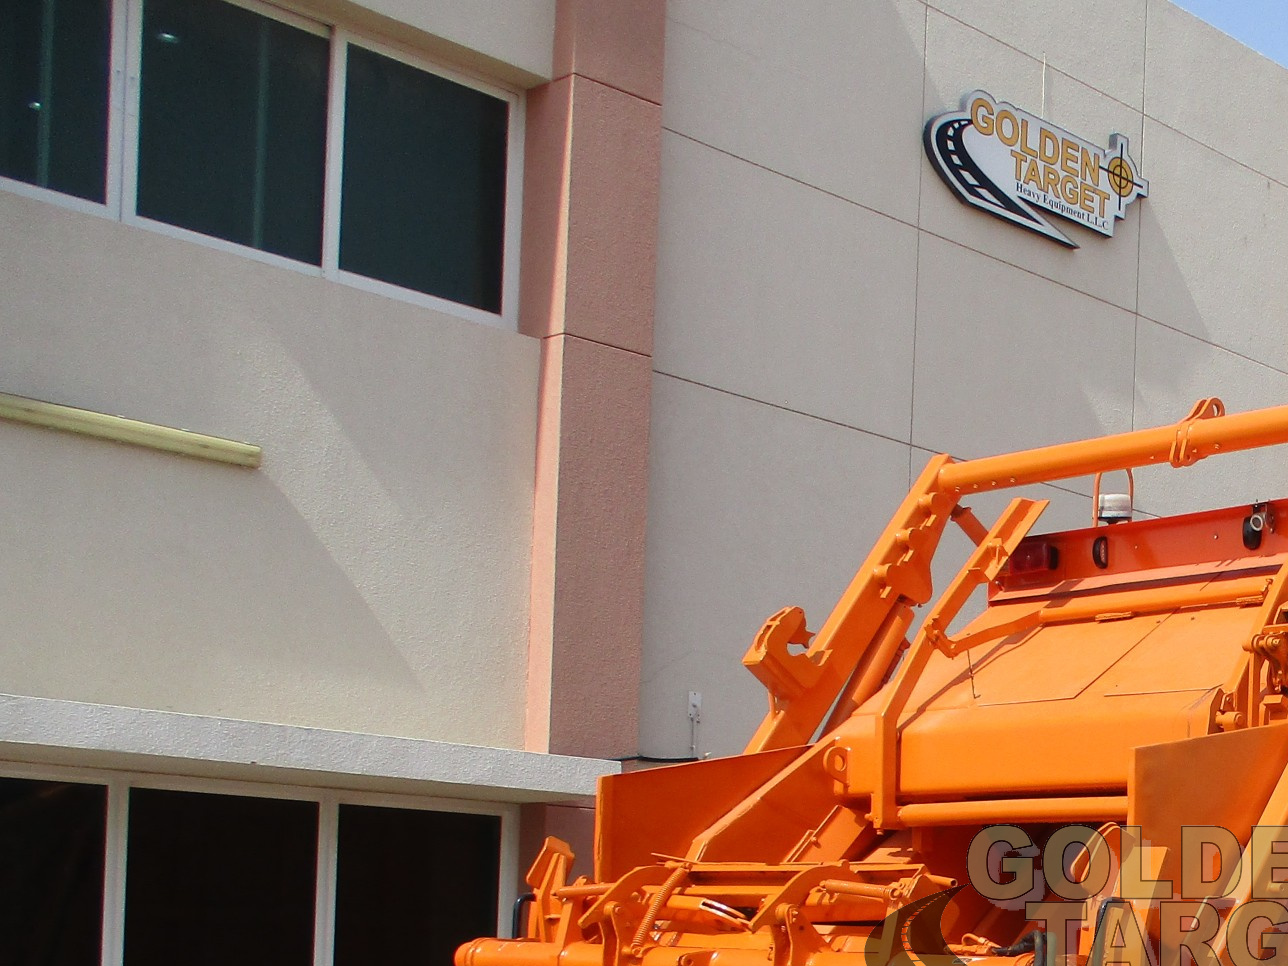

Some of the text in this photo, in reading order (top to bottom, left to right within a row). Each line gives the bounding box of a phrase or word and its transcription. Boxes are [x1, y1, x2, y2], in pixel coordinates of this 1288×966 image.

[970, 97, 1101, 187] GOLDEN
[1010, 149, 1111, 219] TARGET
[1016, 182, 1041, 203] Heavy
[1043, 194, 1087, 220] Equipment
